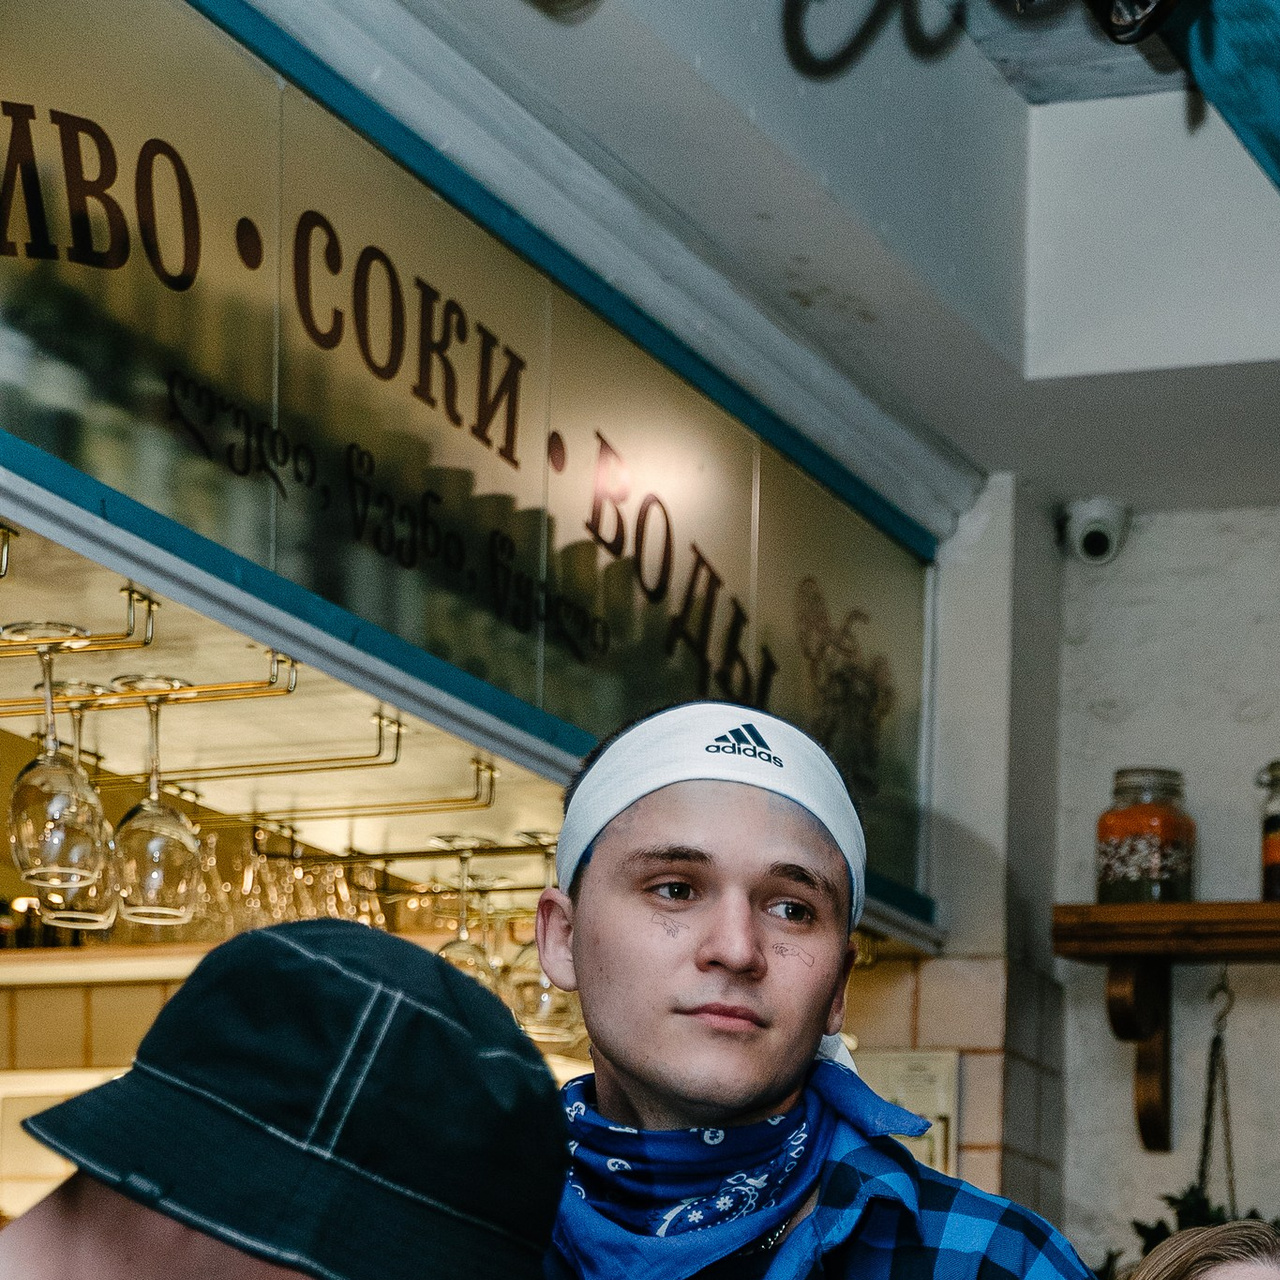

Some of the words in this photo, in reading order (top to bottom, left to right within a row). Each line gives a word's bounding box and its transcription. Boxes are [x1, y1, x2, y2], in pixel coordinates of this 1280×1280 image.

[293, 209, 528, 470] СОКИ
[585, 430, 779, 709] ВОДЫ
[705, 742, 784, 768] adidas
